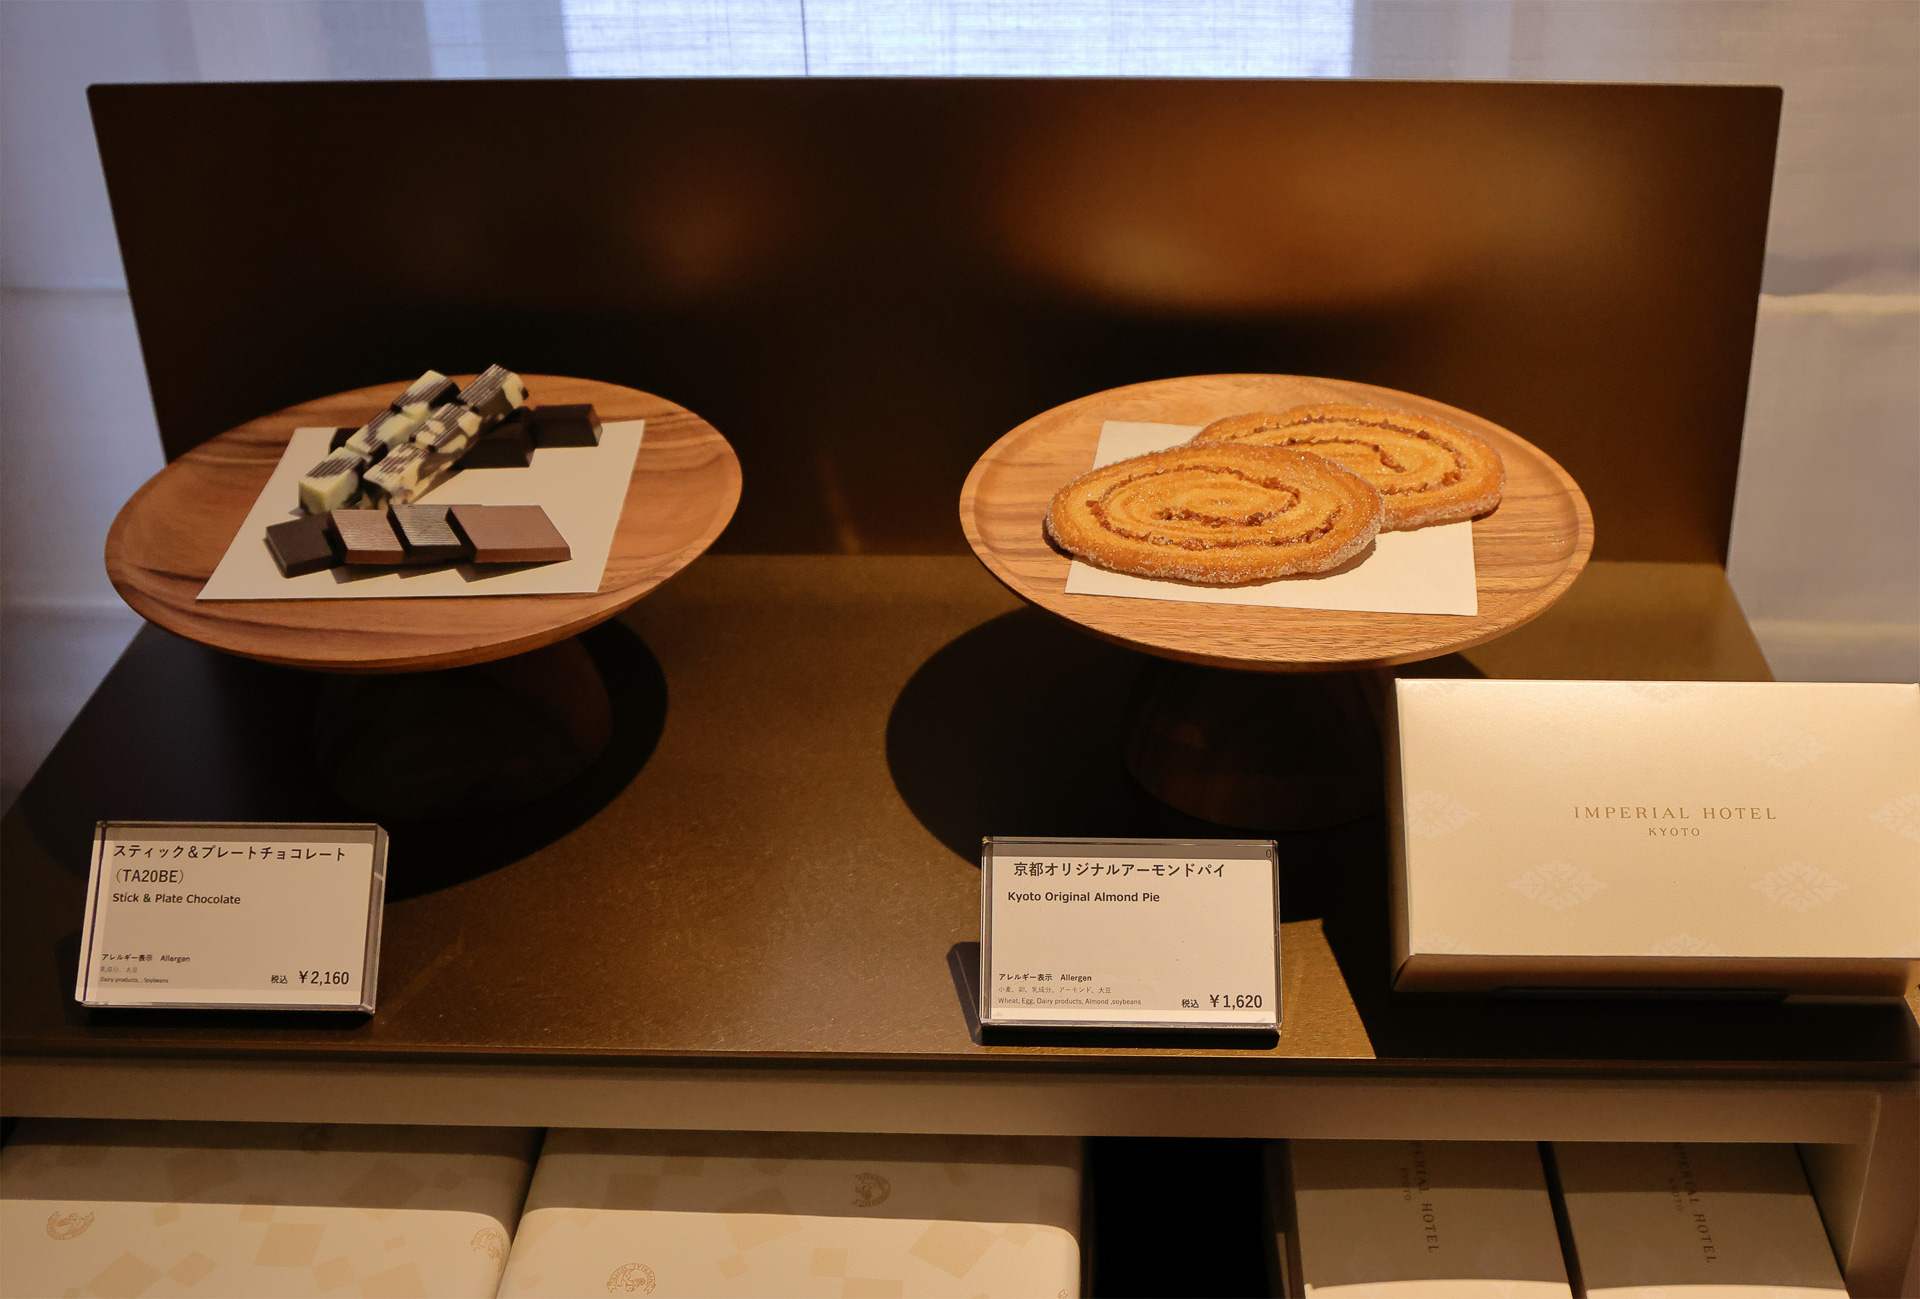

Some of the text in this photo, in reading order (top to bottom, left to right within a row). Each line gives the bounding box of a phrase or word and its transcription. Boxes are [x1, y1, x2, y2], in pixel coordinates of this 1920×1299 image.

[1574, 806, 1777, 820] IMPERIAL HOTEL
[1648, 827, 1700, 837] KYOTO
[113, 844, 347, 862] スティック＆プレートチョコレート
[1013, 861, 1225, 878] 京都オリジナルアーモンドパイ
[112, 892, 241, 905] Stick & Plate Chocolate
[1008, 892, 1160, 904] Kyoto Original Almond Pie
[101, 953, 153, 962] アレルギー表示
[160, 954, 191, 964] Allergen
[270, 974, 288, 984] 税込
[298, 970, 350, 987] ¥2,160
[999, 973, 1053, 982] アレルギー表示
[1060, 974, 1092, 983] Allergen
[1036, 998, 1053, 1006] Dairy
[1055, 998, 1084, 1006] products,
[1181, 999, 1199, 1009] 税込
[1209, 994, 1263, 1011] ¥1,620
[1409, 1141, 1439, 1253] PERIAL HOTEL
[1694, 1214, 1717, 1263] HOTEL
